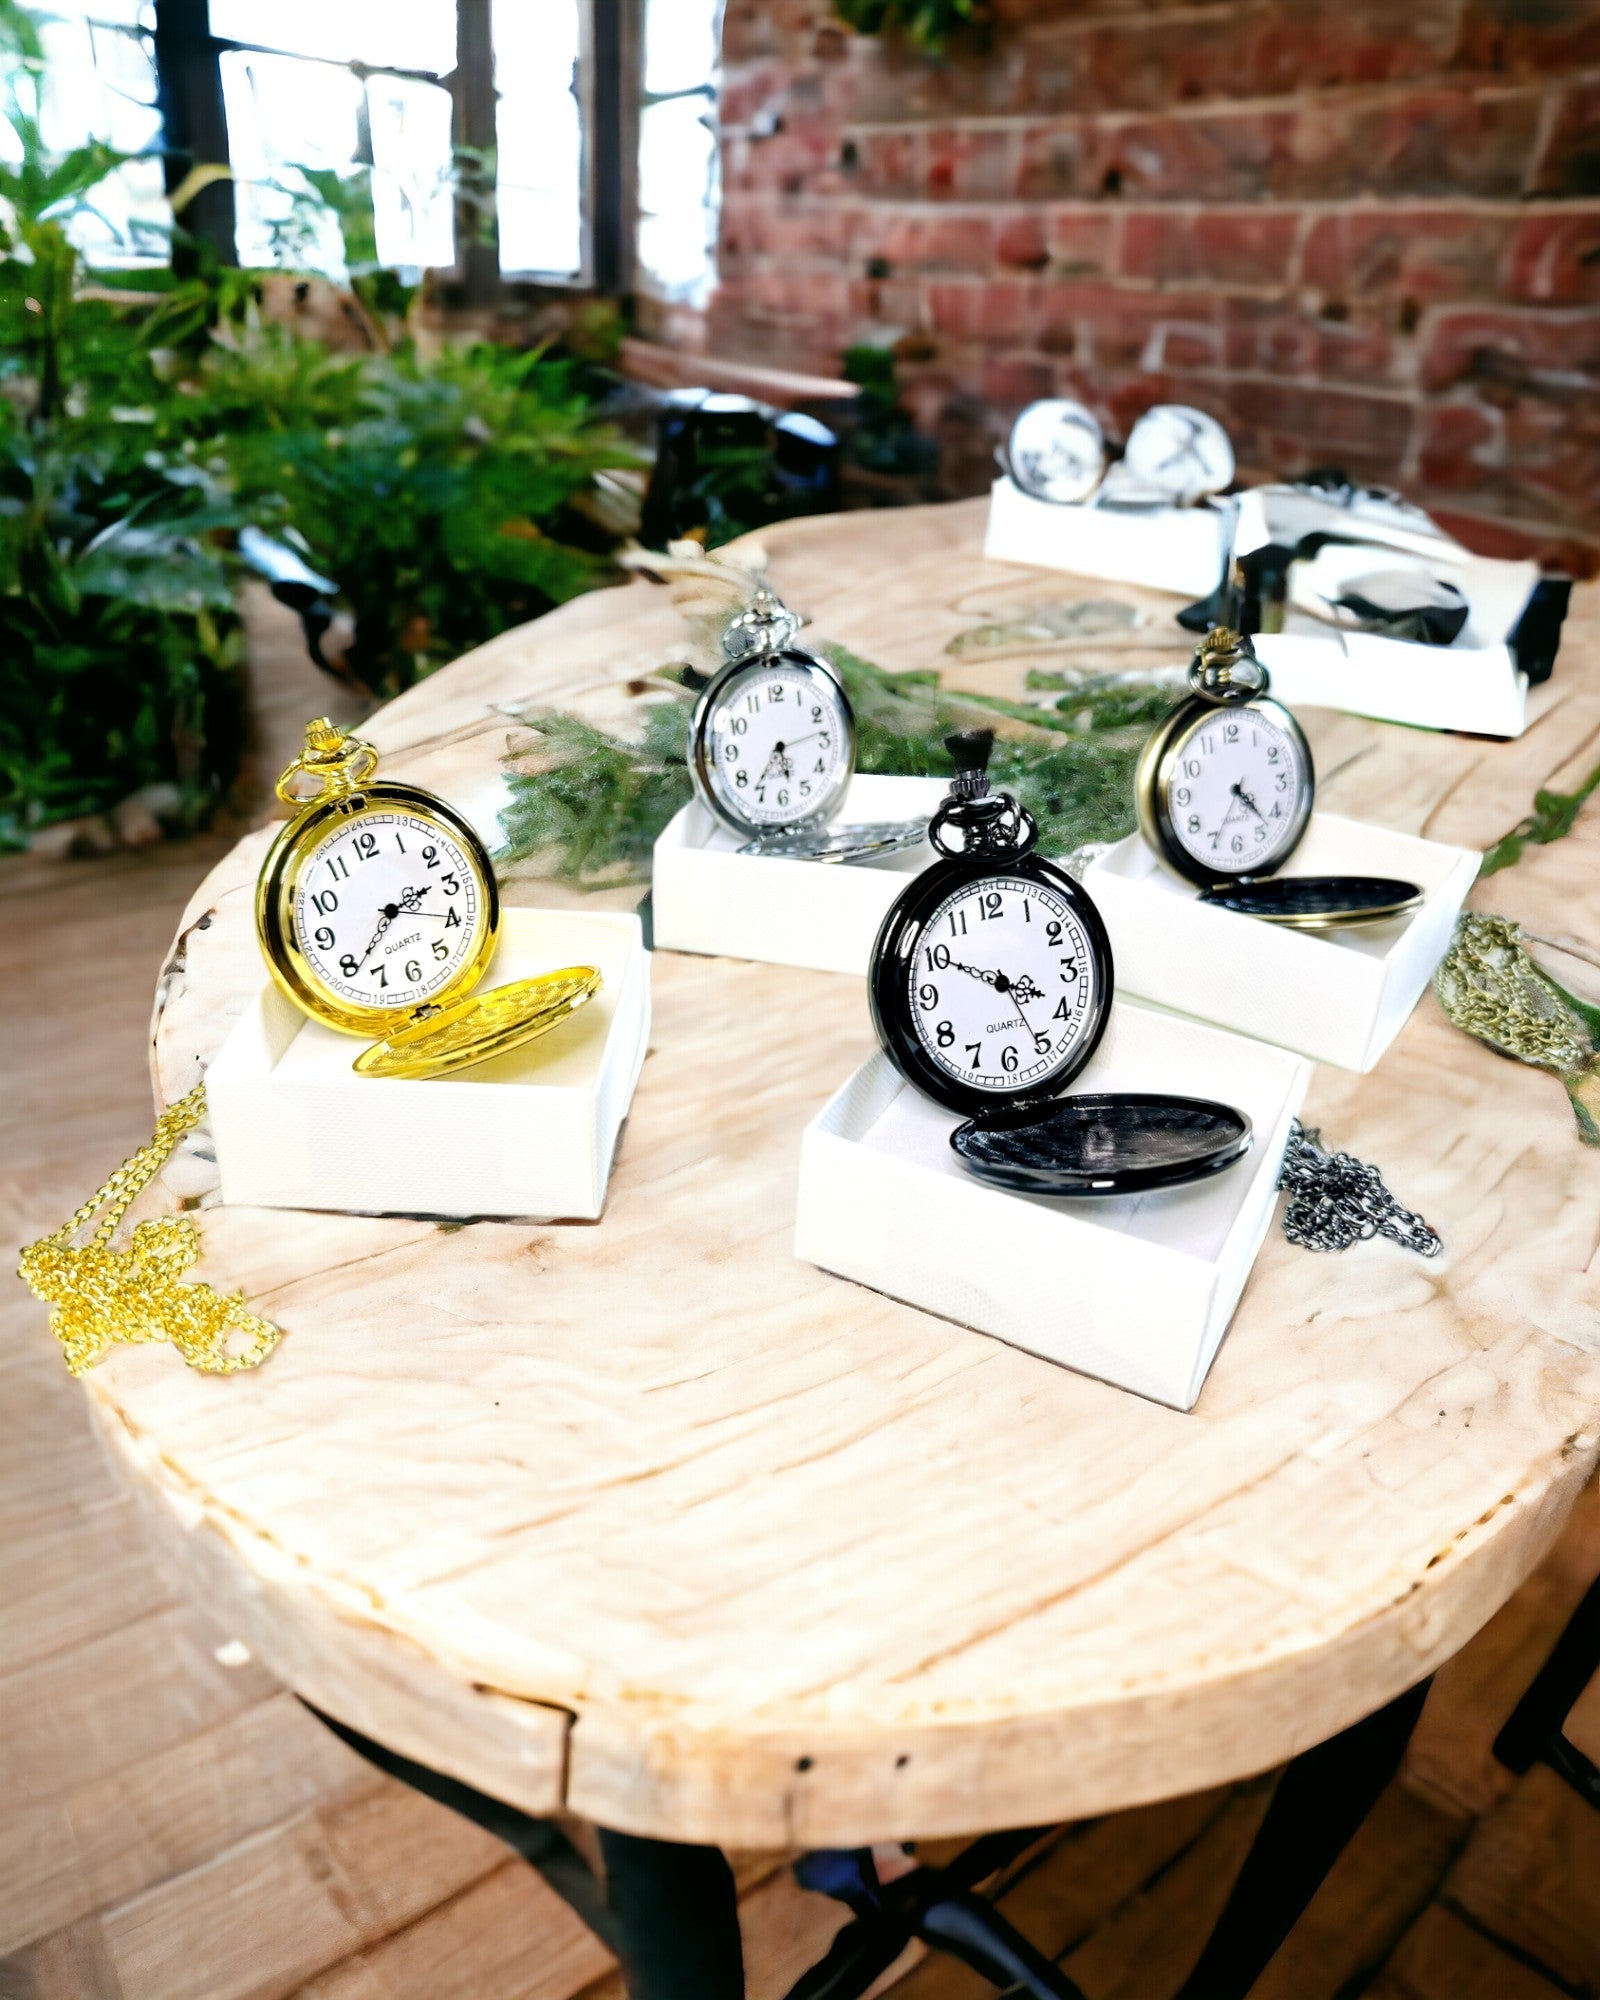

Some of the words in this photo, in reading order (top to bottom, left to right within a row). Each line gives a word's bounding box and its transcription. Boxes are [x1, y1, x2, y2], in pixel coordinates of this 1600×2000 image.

[768, 684, 784, 703] 12
[747, 695, 759, 713] 11
[811, 706, 822, 724] 2
[730, 717, 747, 736] 10
[1223, 724, 1239, 744] 12
[818, 731, 831, 749] 3
[1201, 735, 1214, 754] 11
[725, 744, 738, 762] 9
[1267, 747, 1279, 765] 2
[814, 757, 826, 774] 4
[1183, 760, 1200, 779] 10
[735, 769, 748, 788] 8
[1275, 772, 1287, 792] 3
[755, 785, 766, 804] 7
[777, 789, 789, 807] 6
[799, 780, 811, 797] 5
[1176, 788, 1191, 807] 9
[1268, 801, 1281, 818] 4
[396, 815, 408, 826] 13
[1188, 814, 1200, 834] 8
[1207, 831, 1219, 849] 7
[1254, 824, 1266, 842] 5
[352, 833, 381, 861] 12
[394, 832, 407, 855] 1
[1231, 834, 1243, 853] 6
[422, 845, 441, 869] 2
[326, 855, 351, 882] 11
[461, 870, 472, 884] 15
[441, 871, 460, 896] 3
[1027, 886, 1038, 898] 13
[310, 890, 338, 917] 10
[978, 892, 1004, 921] 12
[1023, 898, 1031, 923] 1
[444, 906, 462, 929] 4
[466, 915, 475, 927] 16
[948, 909, 967, 937] 11
[314, 927, 335, 950] 9
[385, 932, 422, 955] QUARTZ
[1045, 921, 1063, 947] 2
[431, 938, 449, 961] 5
[924, 943, 950, 972] 10
[339, 954, 359, 978] 8
[405, 960, 422, 982] 6
[450, 956, 461, 970] 17
[1059, 956, 1078, 982] 3
[1078, 961, 1088, 973] 15
[329, 978, 343, 990] 20
[370, 964, 390, 988] 7
[373, 994, 385, 1004] 19
[416, 984, 428, 998] 18
[919, 983, 939, 1011] 9
[1052, 995, 1073, 1021] 4
[1074, 1009, 1083, 1023] 16
[936, 1020, 955, 1048] 8
[986, 1017, 1026, 1034] QUARTZ
[1034, 1029, 1052, 1055] 5
[965, 1042, 982, 1069] 7
[1001, 1045, 1019, 1072] 6
[1006, 1074, 1018, 1085] 18
